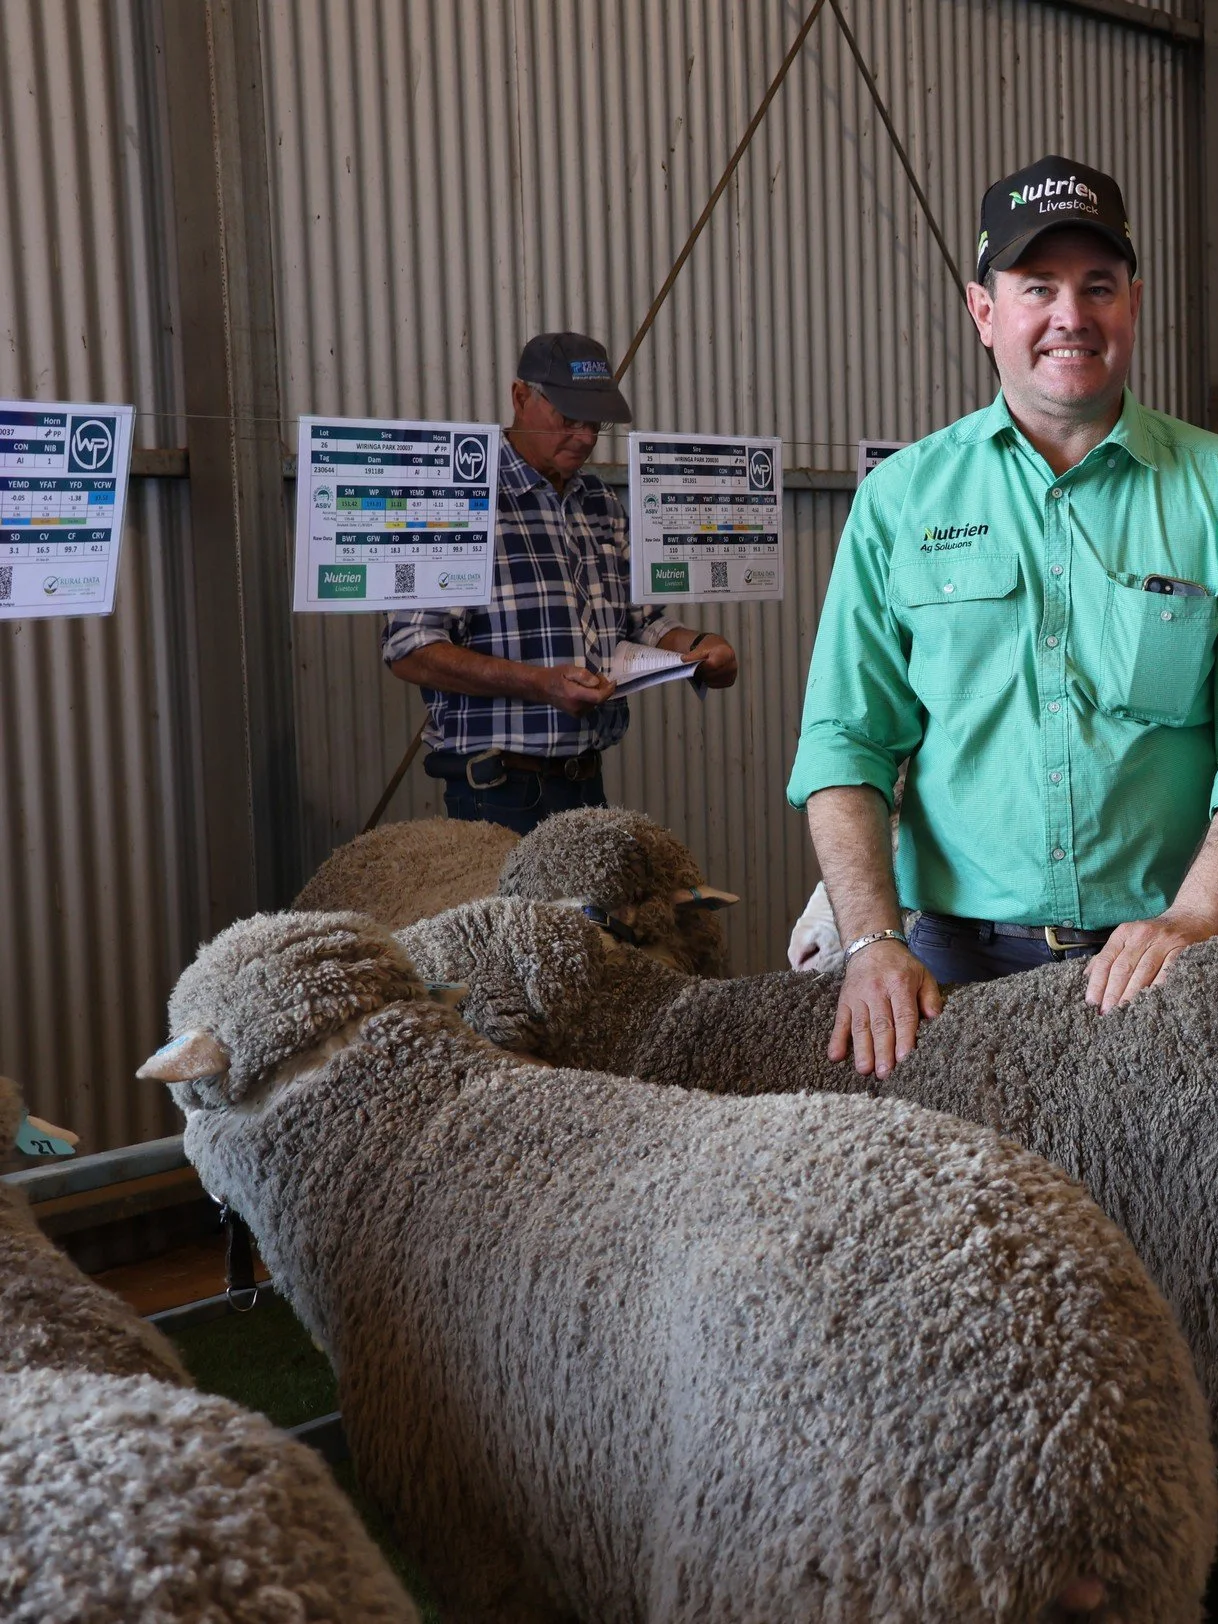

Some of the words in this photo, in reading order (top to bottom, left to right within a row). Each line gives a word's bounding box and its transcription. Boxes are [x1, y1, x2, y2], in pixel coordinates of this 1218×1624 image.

[1009, 175, 1098, 210] Nutrien
[1039, 199, 1099, 215] Livestock
[44, 417, 61, 425] Horn
[13, 443, 29, 451] CON
[44, 444, 57, 452] NIB
[8, 481, 30, 489] YEMD
[39, 481, 57, 489] YFAT
[69, 481, 82, 489] YFD
[93, 481, 112, 489] YCFW
[923, 523, 989, 541] Nutrien
[920, 544, 933, 553] Ag
[934, 540, 972, 551] Solutions
[324, 571, 362, 583] Nutrien
[656, 568, 685, 579] Nutrien
[30, 1140, 56, 1155] 27
